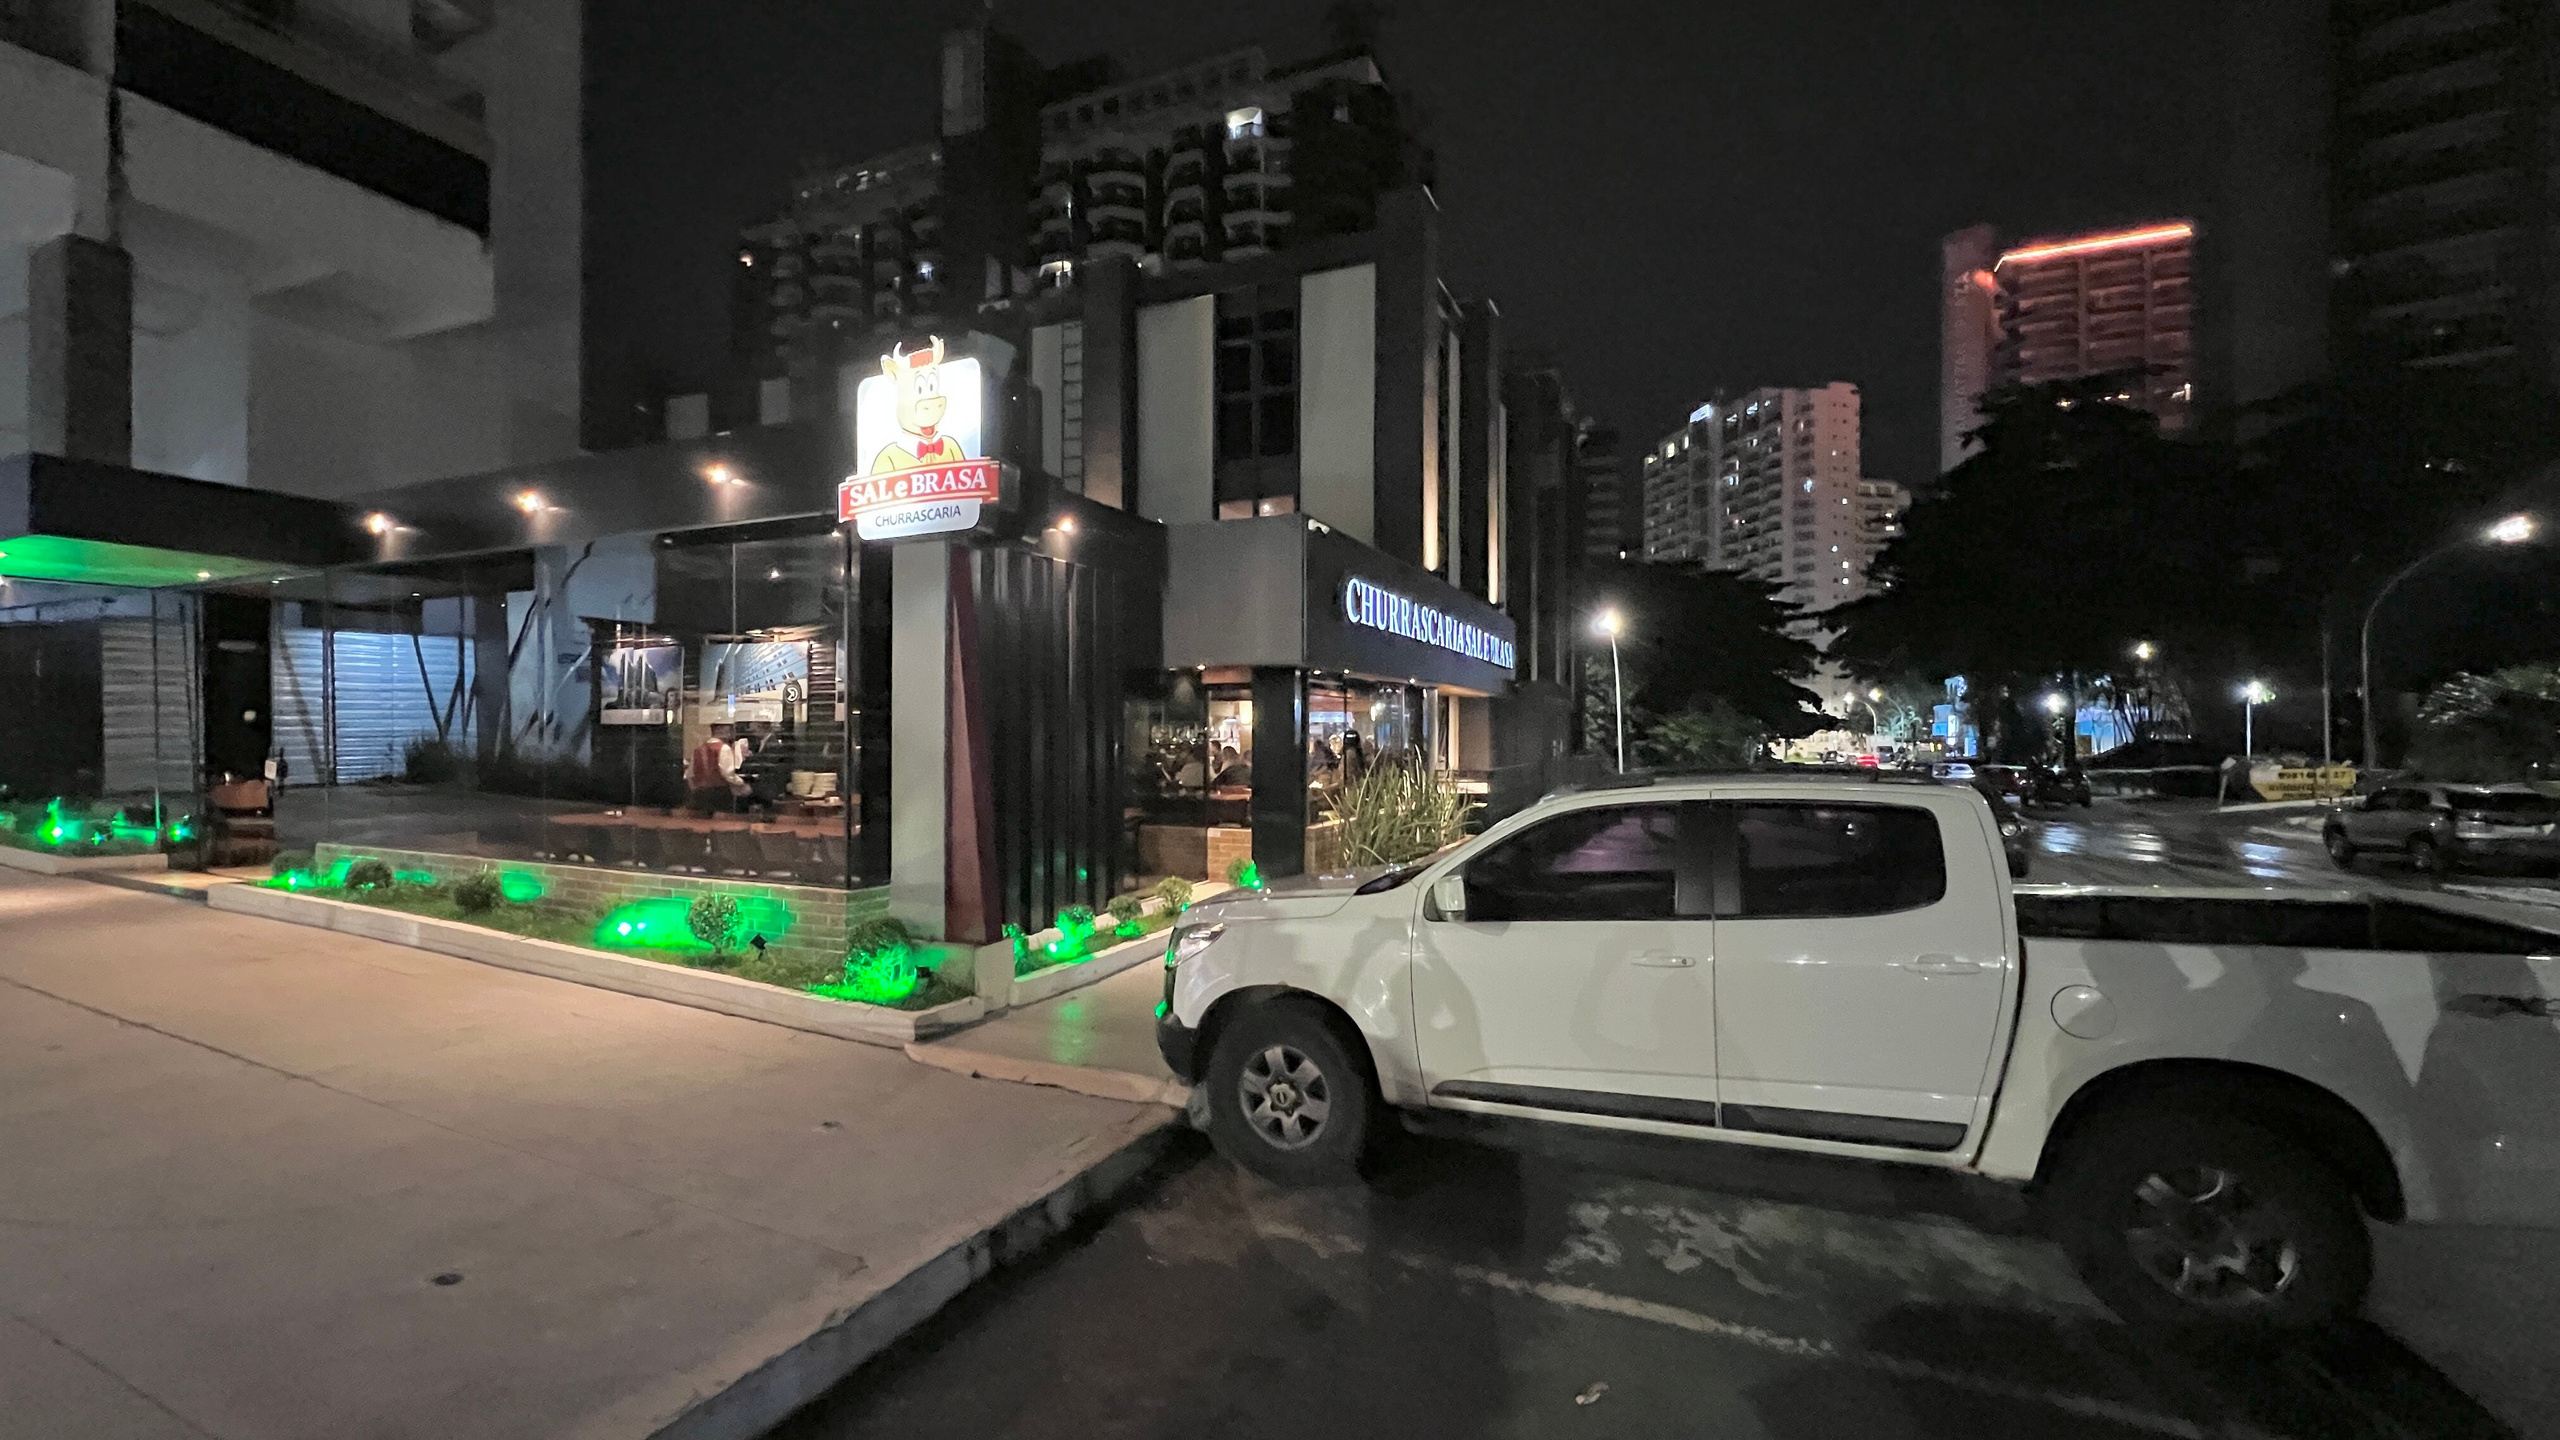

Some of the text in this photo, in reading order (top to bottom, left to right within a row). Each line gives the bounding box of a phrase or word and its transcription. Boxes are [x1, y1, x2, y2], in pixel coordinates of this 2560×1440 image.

[849, 468, 988, 507] SAL e BRASA
[875, 505, 961, 528] CHURRASCARIA
[1345, 577, 1514, 670] CHURRASCARIA SAL E BRASA
